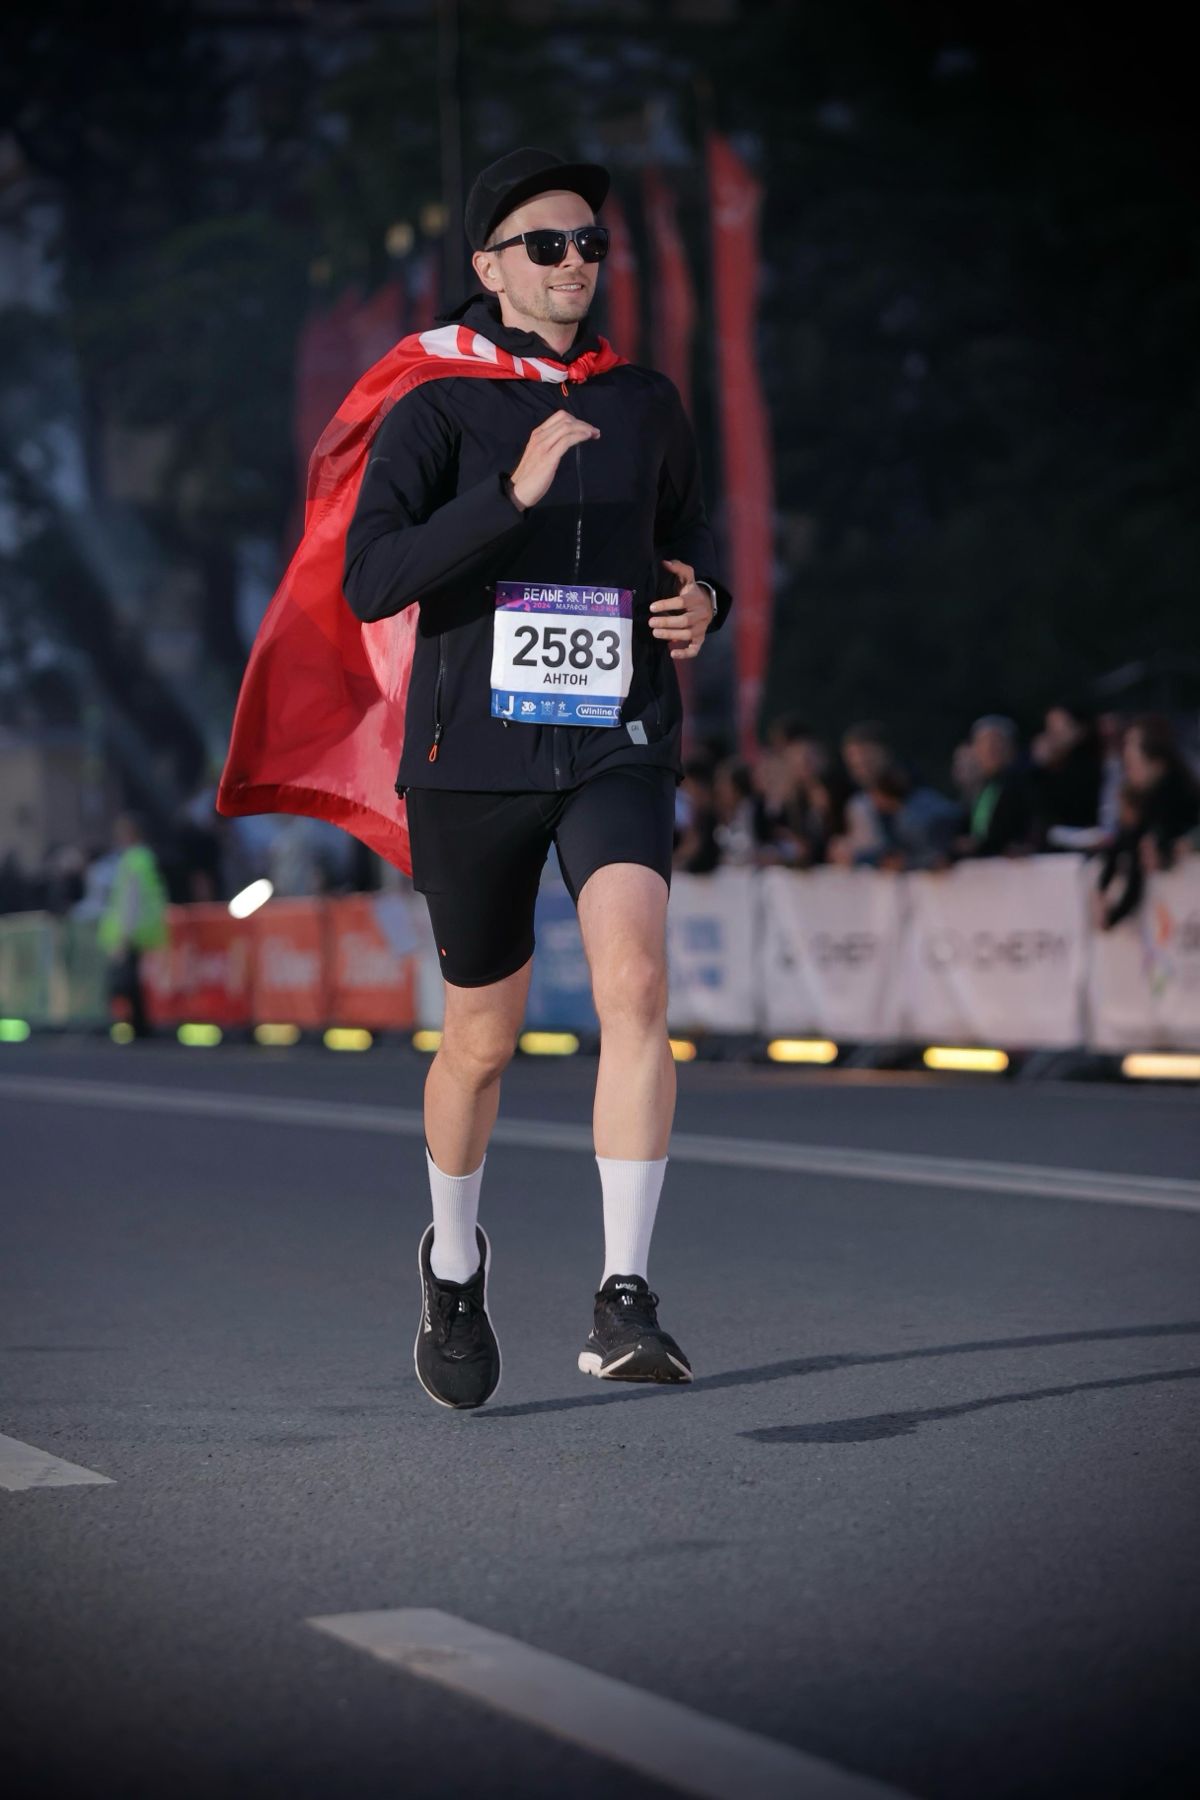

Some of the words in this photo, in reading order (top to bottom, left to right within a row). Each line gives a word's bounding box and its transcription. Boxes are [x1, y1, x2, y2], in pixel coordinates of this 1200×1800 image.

[524, 588, 563, 602] БЕЛЫЕ
[582, 591, 618, 605] НОЧИ
[555, 603, 588, 611] МАРАФОН
[512, 625, 620, 671] 2583
[543, 672, 588, 686] АНТОН
[580, 707, 612, 716] Winline
